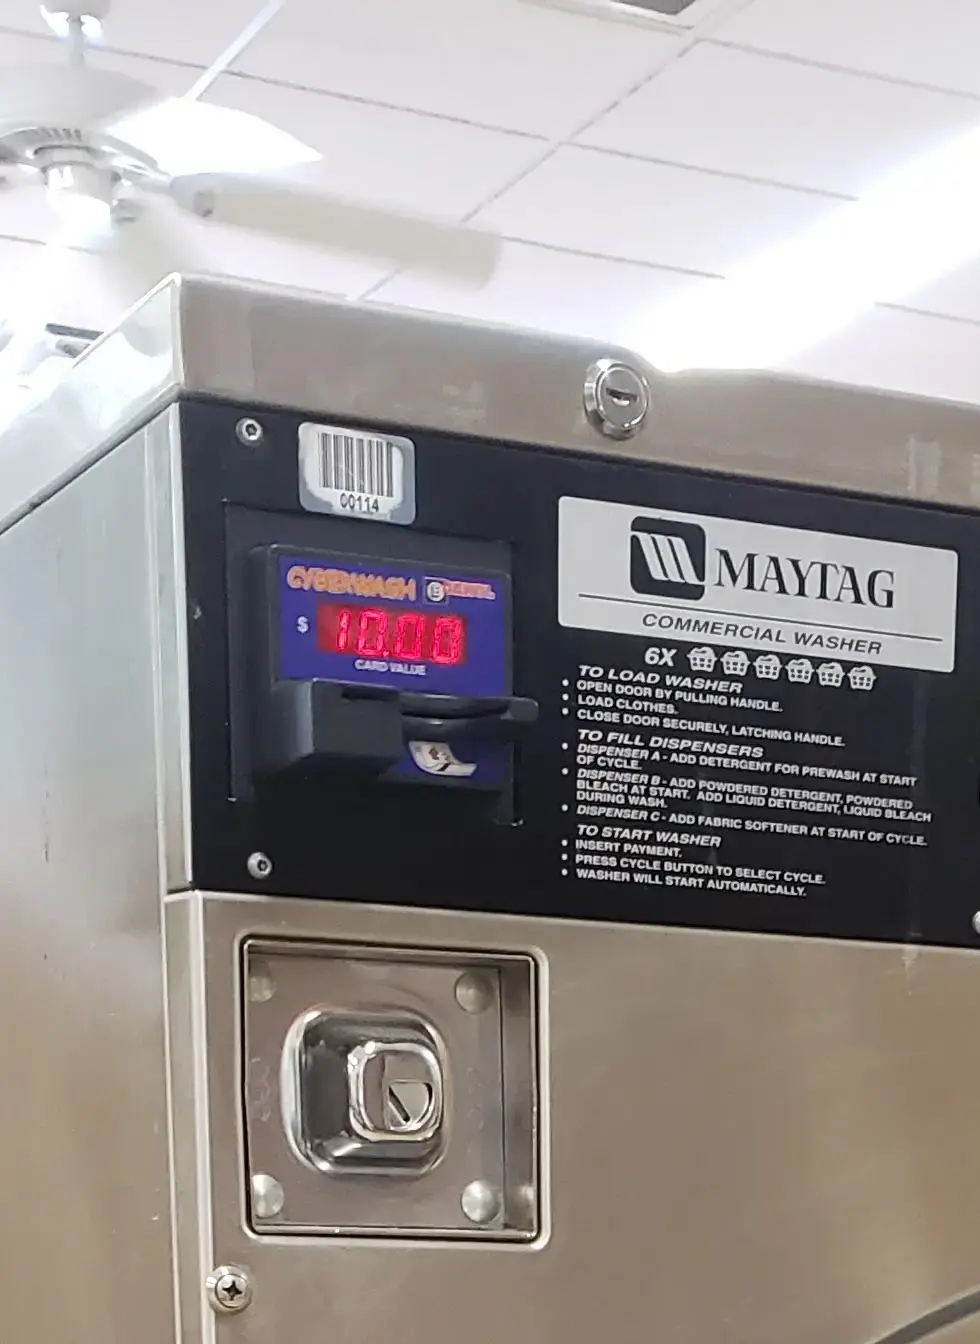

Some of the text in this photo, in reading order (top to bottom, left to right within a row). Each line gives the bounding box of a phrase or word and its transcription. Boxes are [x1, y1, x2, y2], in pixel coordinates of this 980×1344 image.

[340, 493, 379, 512] 00114
[714, 548, 895, 608] MAYTAG
[297, 617, 309, 633] $
[336, 608, 463, 664] 10.00
[642, 613, 882, 655] COMMERCIAL WASHER
[355, 660, 426, 675] CARD VALUE
[644, 647, 677, 667] 6X
[579, 665, 743, 694] TO LOAD WASHER
[576, 681, 783, 712] OPEN DOOR BY PULLING HANDLE.
[578, 695, 678, 714] LOAD CLOTHES.
[577, 709, 845, 747] CLOSE DOOR SECURELY, LATCHING HANDLE.
[578, 729, 764, 758] TO FILL DISPENSERS
[577, 755, 642, 770] OF CYCLE.
[577, 744, 649, 759] DISPENSER
[651, 751, 660, 761] A
[670, 753, 696, 764] ADD
[700, 756, 772, 772] DETERGENT
[774, 763, 799, 775] FOR
[802, 766, 860, 782] PREWASH
[863, 773, 877, 783] AT
[880, 774, 916, 787] START
[576, 791, 668, 808] DURING WASH.
[577, 768, 648, 784] DISPENSER
[651, 776, 660, 785] B
[670, 778, 696, 788] ADD
[699, 781, 768, 795] POWDERED
[846, 795, 913, 809] POWDERED
[577, 780, 931, 823] BLEACH AT START. ADD LIQUID DETERGENT, LIQUID BLEACH
[576, 805, 648, 820] DISPENSER
[651, 812, 660, 821] C
[669, 814, 695, 825] ADD
[698, 816, 742, 829] FABRIC
[745, 820, 808, 835] SOFTENER
[811, 827, 825, 836] AT
[828, 828, 865, 841] START
[867, 831, 884, 842] OF
[886, 834, 928, 846] CYCLE.
[577, 825, 722, 847] TO START WASHER
[576, 840, 682, 858] INSERT PAYMENT.
[576, 854, 826, 884] PRESS CYCLE BUTTON TO SELECT CYCLE.
[577, 868, 806, 897] WASHER WILL START AUTOMATICALLY.
